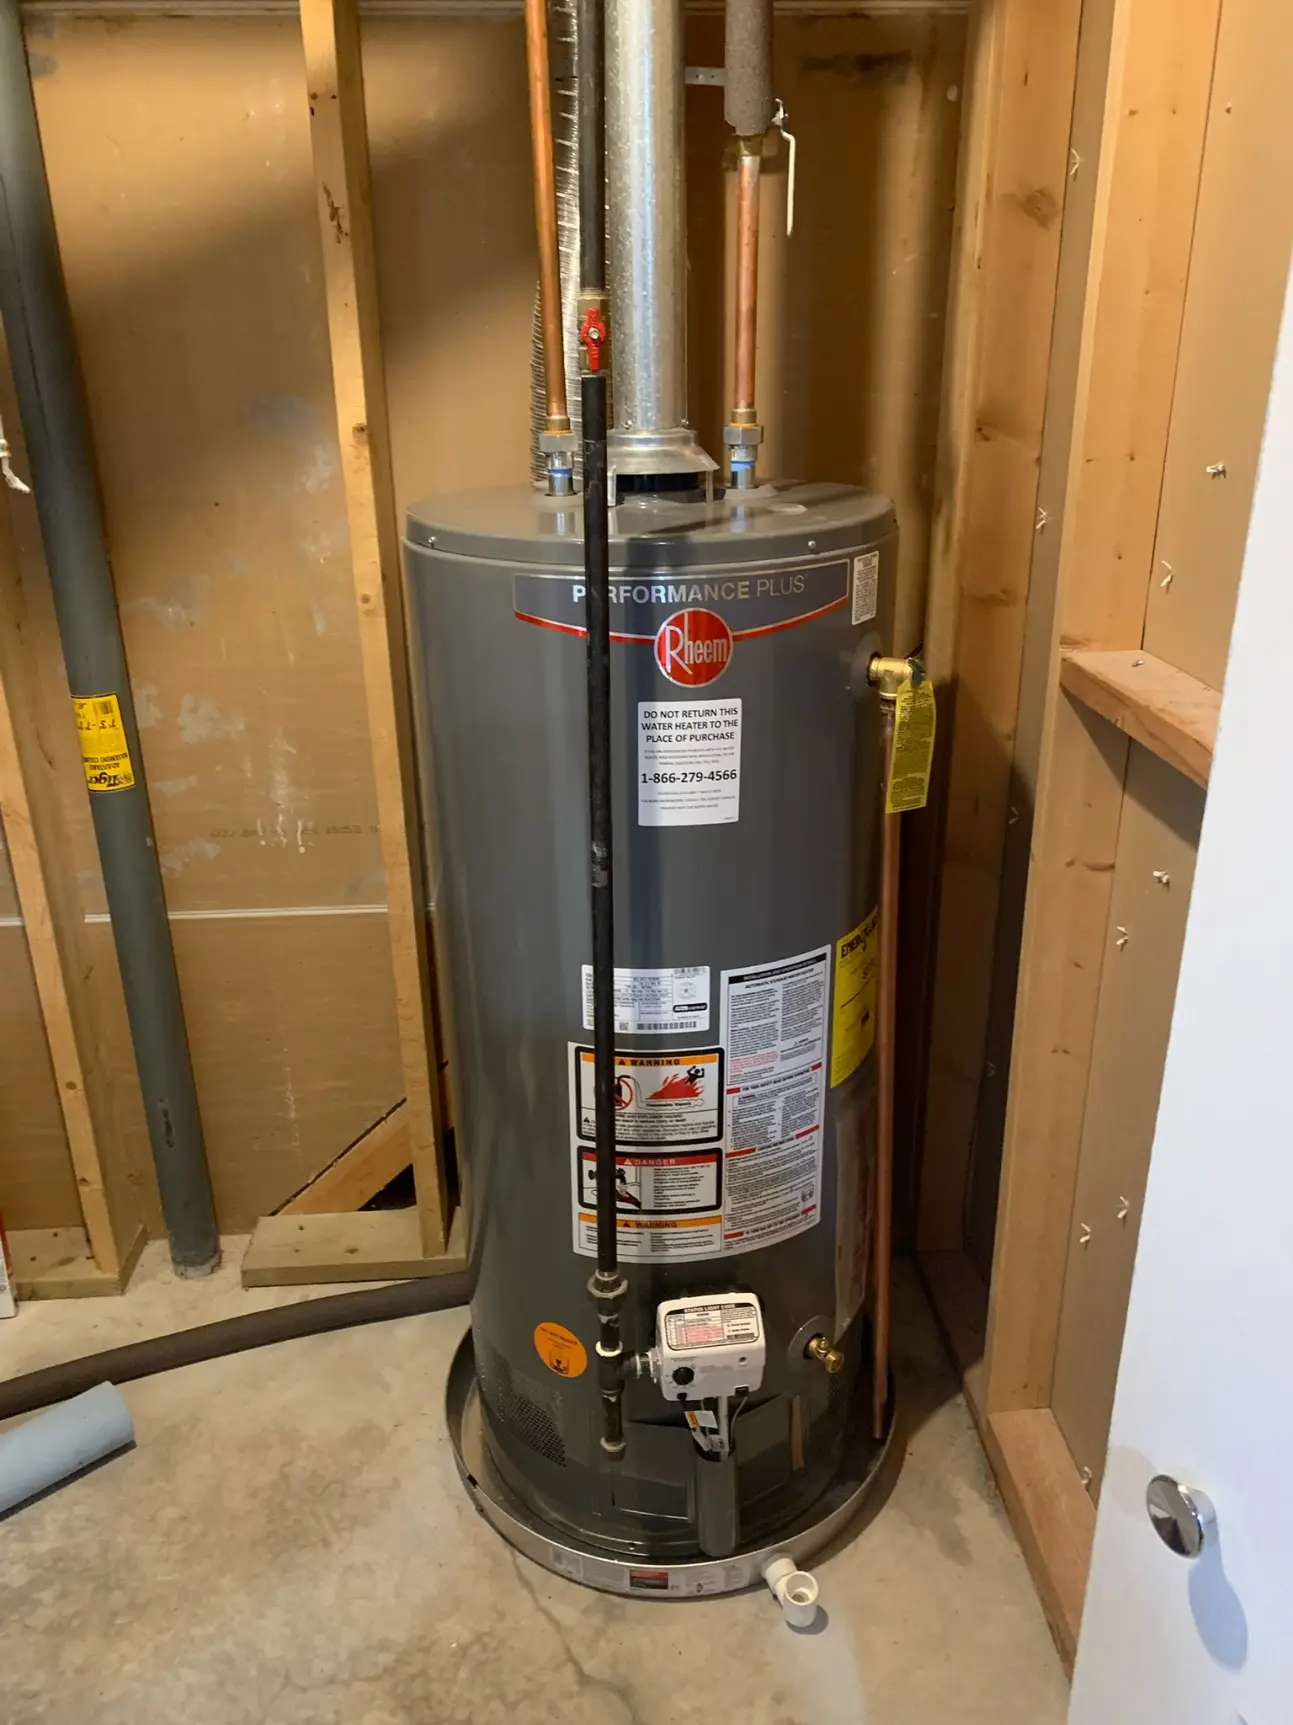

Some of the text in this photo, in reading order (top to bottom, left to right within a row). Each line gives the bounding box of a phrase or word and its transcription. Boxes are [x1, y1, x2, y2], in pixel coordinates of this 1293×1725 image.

[572, 575, 805, 604] PRFORMANCE PLUS
[665, 612, 727, 674] Rheem
[644, 707, 738, 718] DO NOT RETURN THIS
[641, 722, 673, 731] WATER
[675, 722, 708, 730] HEATER
[723, 719, 738, 727] THE
[675, 734, 687, 742] OF
[689, 732, 734, 742] PURCHASE
[641, 769, 737, 784] 1-866-279-4566
